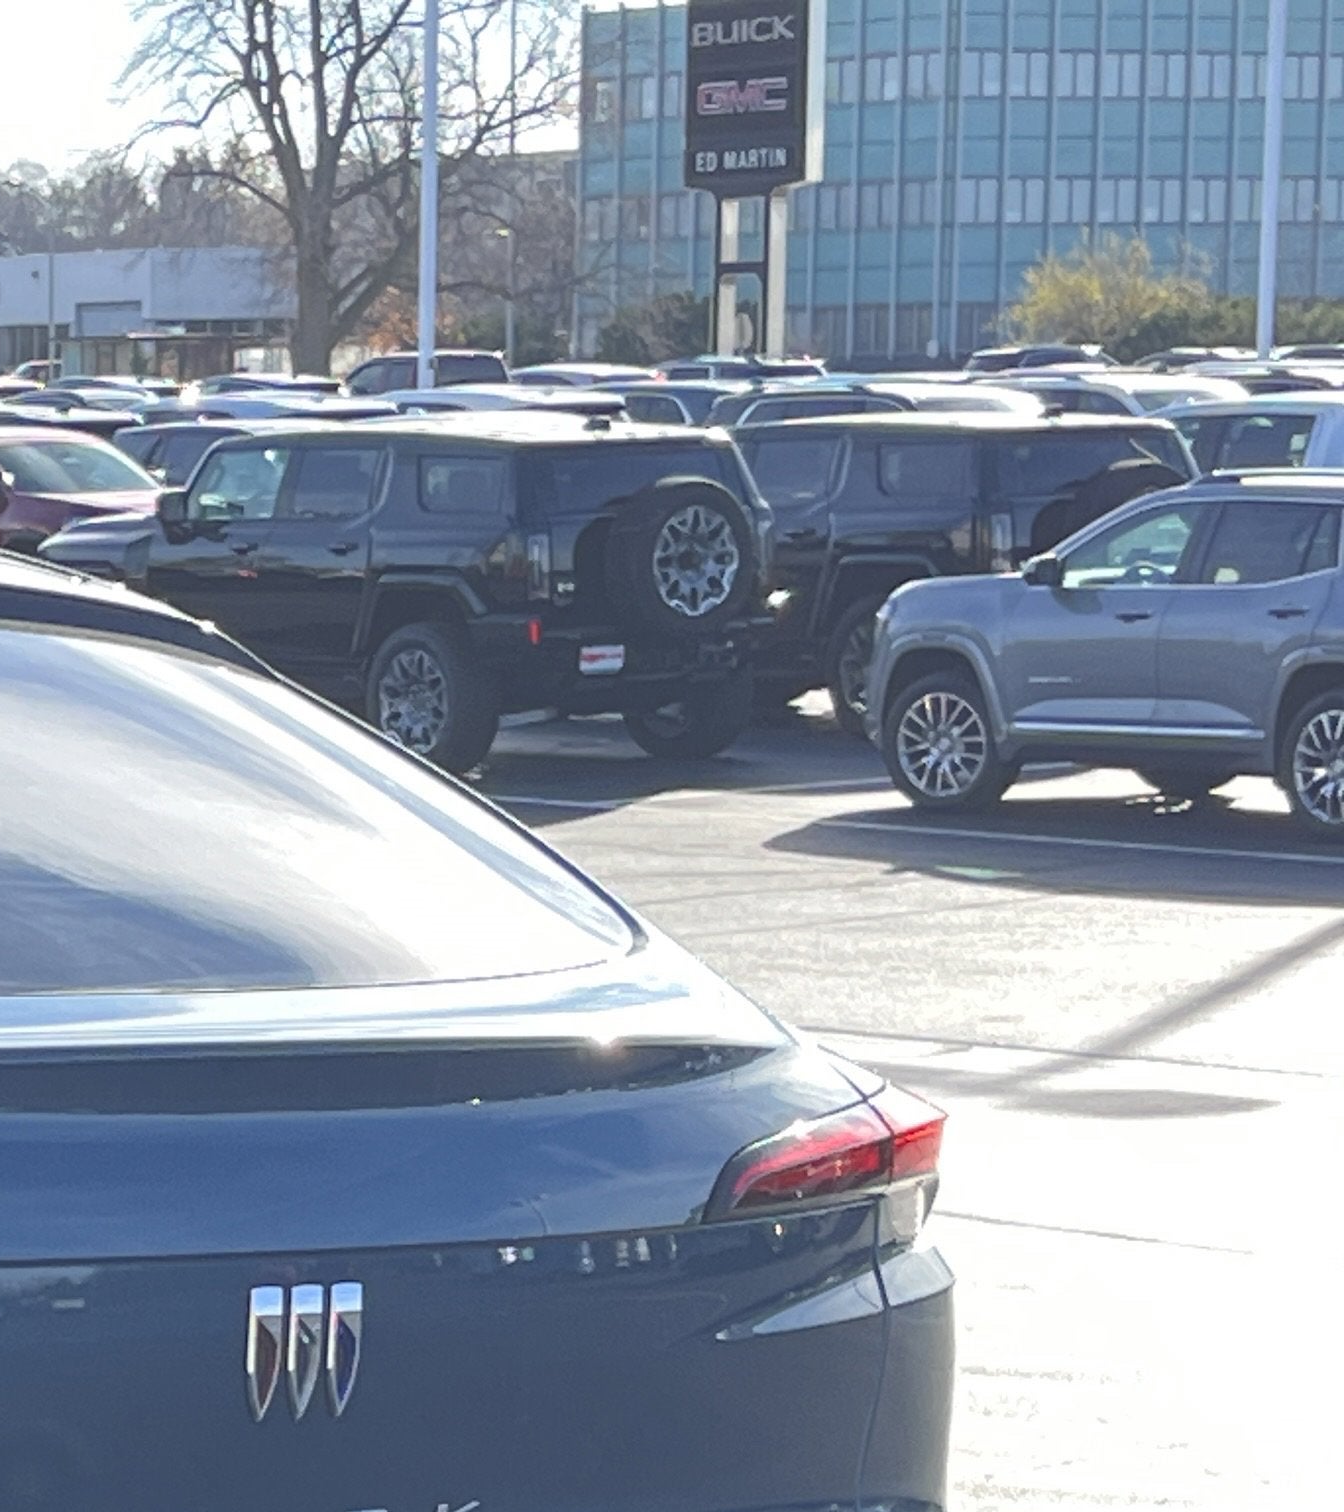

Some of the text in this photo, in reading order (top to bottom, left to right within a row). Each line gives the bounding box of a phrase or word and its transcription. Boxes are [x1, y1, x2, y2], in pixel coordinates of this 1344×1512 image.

[691, 15, 795, 47] BUICK
[696, 76, 789, 116] GMC
[694, 148, 788, 173] ED MARTIN
